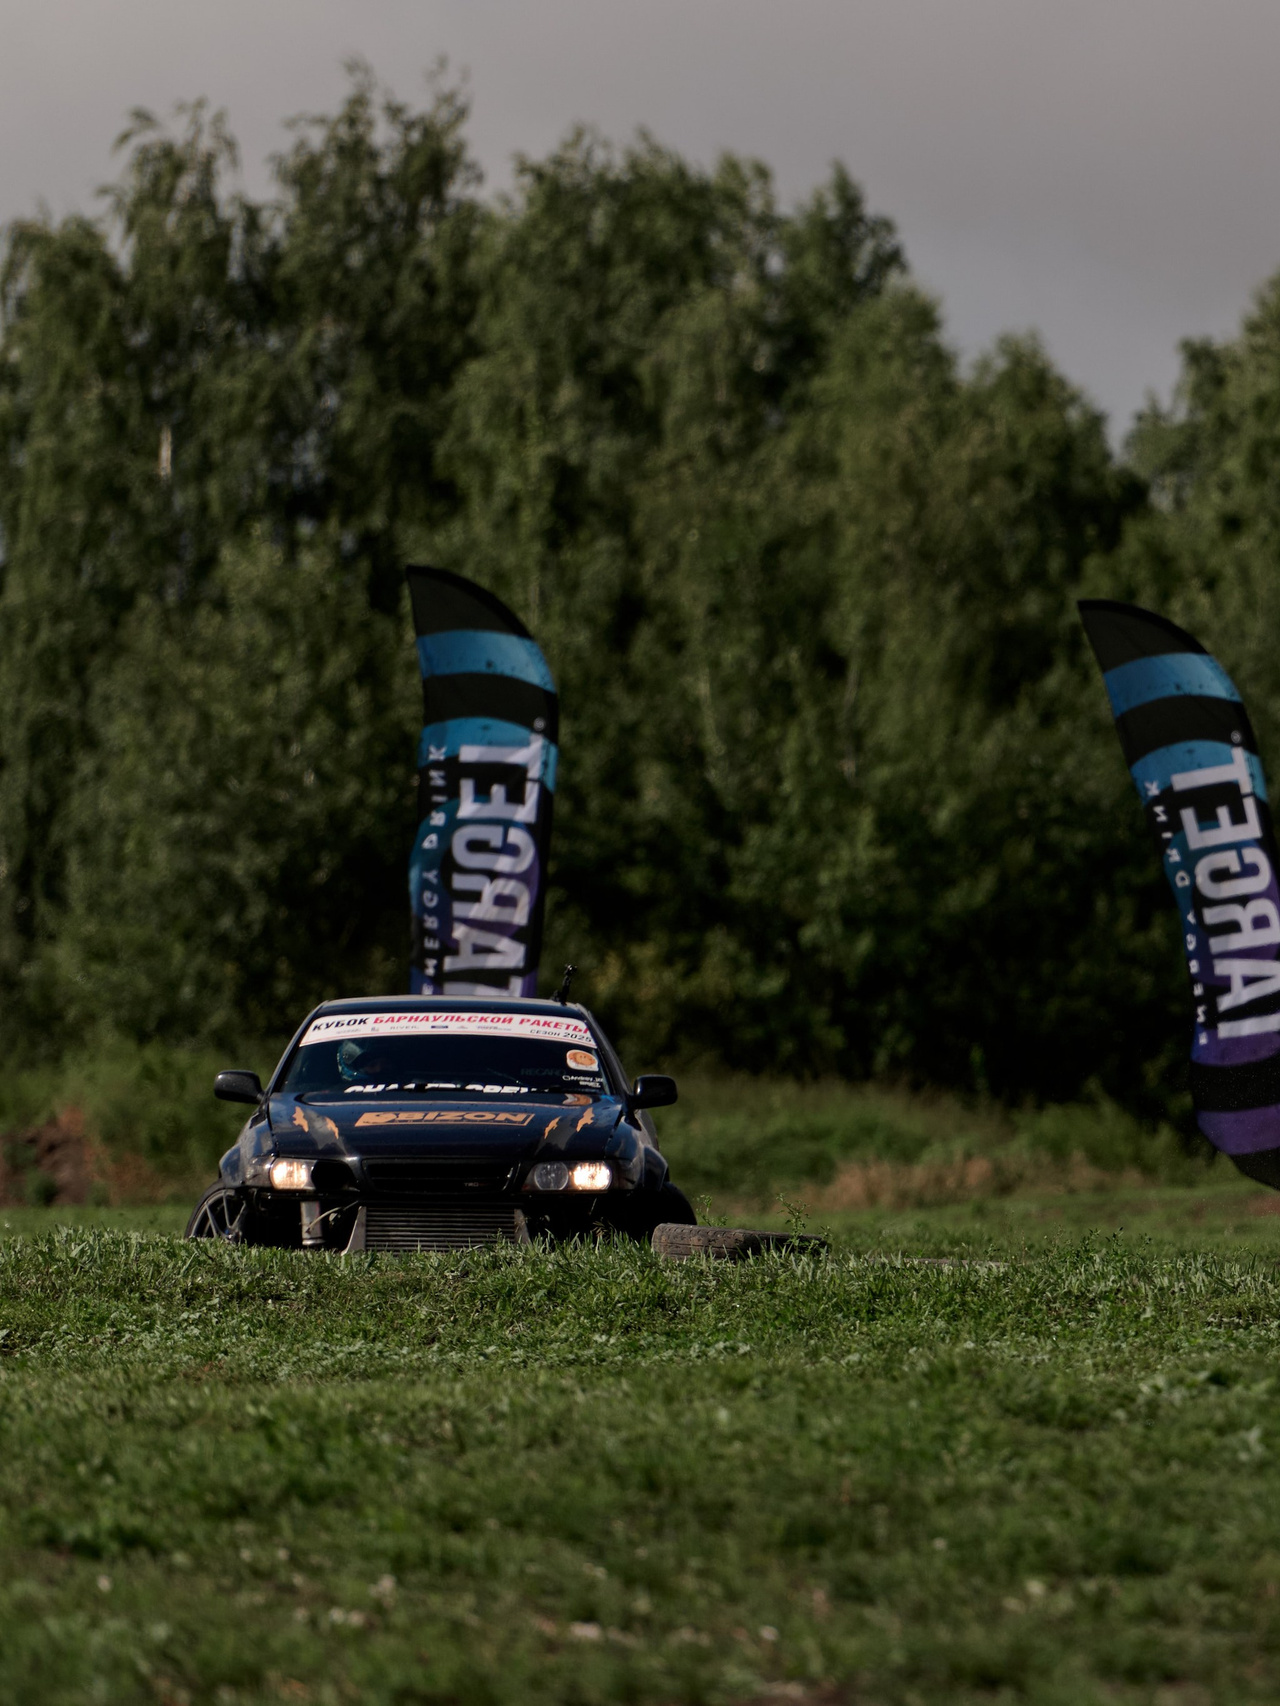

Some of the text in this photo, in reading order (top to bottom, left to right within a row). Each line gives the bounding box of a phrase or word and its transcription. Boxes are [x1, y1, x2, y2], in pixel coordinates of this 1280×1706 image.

[312, 1017, 370, 1032] КУБОК
[373, 1014, 514, 1025] БАРНАУЛЬСКОЙ
[519, 1017, 591, 1034] РАКЕТЫ
[530, 1029, 592, 1043] СЕЗОН 2025
